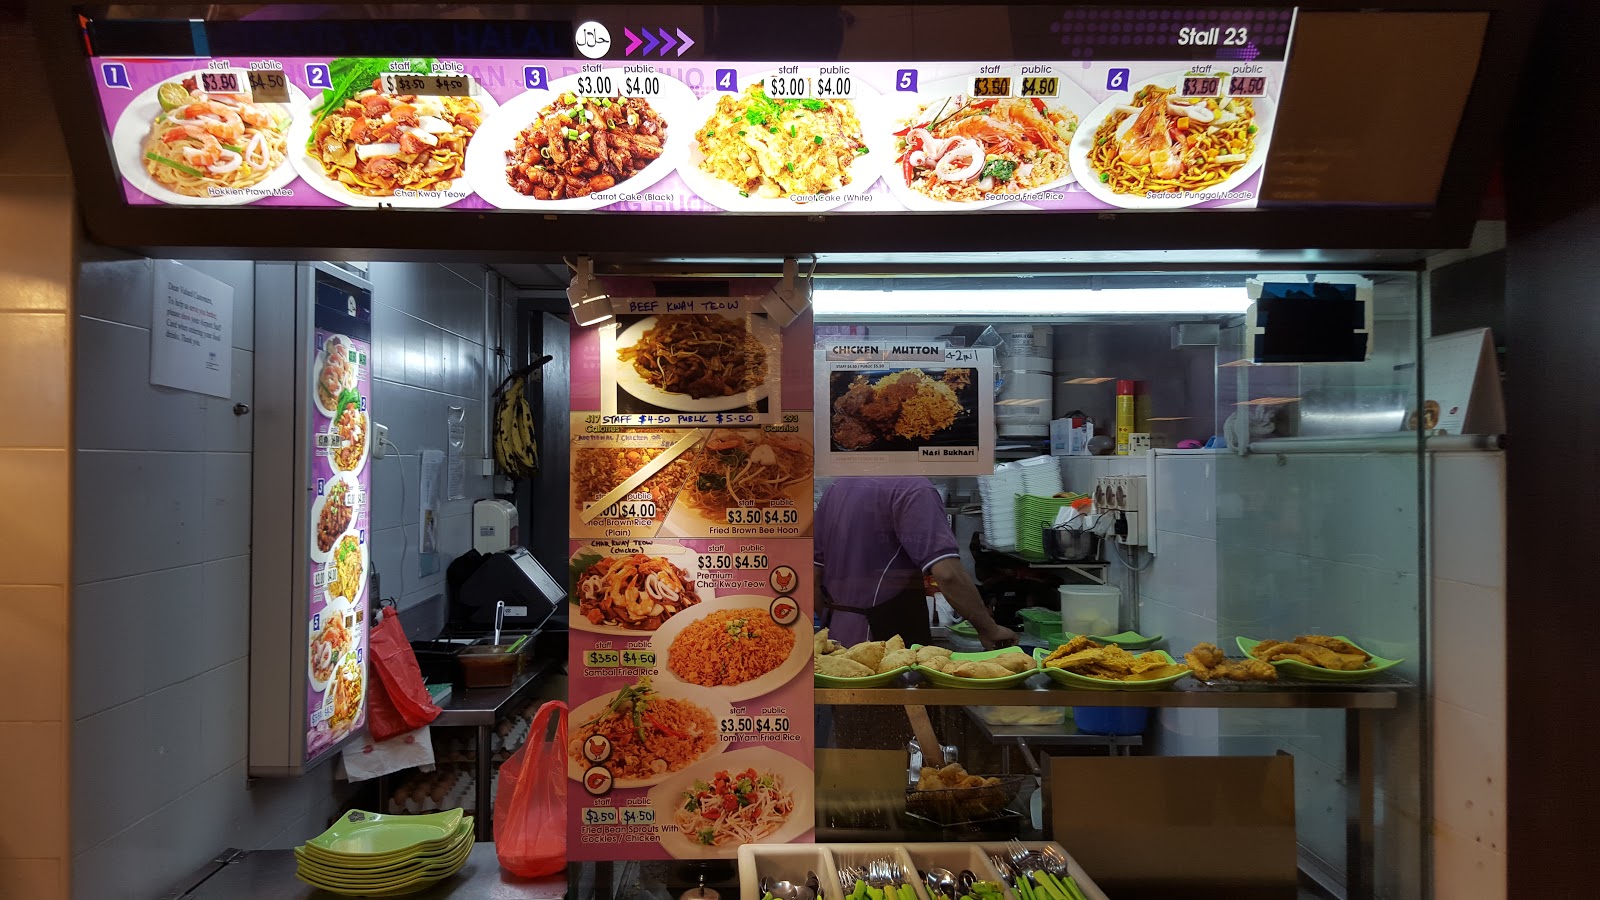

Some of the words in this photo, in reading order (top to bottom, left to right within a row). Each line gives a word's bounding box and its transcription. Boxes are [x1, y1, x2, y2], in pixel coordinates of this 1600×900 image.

[1178, 27, 1220, 45] Stall
[1223, 27, 1248, 45] 23
[209, 60, 230, 70] staff
[251, 60, 282, 70] public
[390, 61, 410, 70] staff
[432, 62, 463, 72] public
[582, 64, 602, 73] staff
[624, 64, 654, 74] public
[779, 66, 798, 74] staff
[980, 65, 1000, 74] staff
[1192, 65, 1212, 74] staff
[1232, 65, 1263, 74] public
[820, 66, 850, 76] public
[1022, 66, 1052, 75] public
[110, 68, 118, 84] 1
[313, 69, 322, 84] 2
[530, 70, 540, 86] 3
[720, 72, 731, 88] 4
[900, 72, 912, 88] 5
[1110, 72, 1122, 88] 6
[578, 76, 612, 96] $3.00
[626, 77, 660, 96] $4.00
[772, 78, 804, 97] $3.00
[818, 78, 850, 96] $4.00
[208, 187, 244, 196] Hokkien
[246, 188, 272, 196] Prawn
[394, 189, 416, 198] Char
[418, 190, 442, 199] Kway
[443, 190, 466, 198] Teow
[985, 193, 1022, 201] Seafood
[1023, 192, 1044, 201] Fried
[1045, 193, 1064, 201] Rice
[1184, 192, 1218, 200] Punggol
[590, 192, 617, 200] Carrot
[618, 192, 642, 201] Cake
[644, 192, 674, 202] (Black)
[818, 194, 842, 202] Cake
[844, 194, 873, 203] (White)
[630, 302, 659, 312] BEEF
[666, 301, 694, 312] KWAY
[701, 300, 739, 311] TEOW
[832, 346, 879, 354] CHICKEN
[892, 346, 939, 355] MUTTON
[602, 415, 632, 425] STAFF
[678, 415, 709, 424] PUBLIC
[764, 424, 798, 432] Calories
[628, 492, 652, 500] public
[622, 504, 654, 518] $4.00
[728, 510, 760, 524] $3.50
[764, 510, 798, 524] $4.50
[605, 529, 631, 538] (Plain)
[740, 544, 764, 552] public
[698, 555, 731, 569] $3.50
[734, 555, 768, 570] $4.50
[720, 580, 742, 590] Kway
[595, 641, 612, 649] staff
[628, 641, 652, 649] public
[762, 707, 786, 715] public
[721, 718, 752, 733] $3.50
[756, 718, 790, 733] $4.50
[594, 798, 612, 806] staff
[627, 798, 652, 806] public
[628, 826, 659, 834] Sprouts
